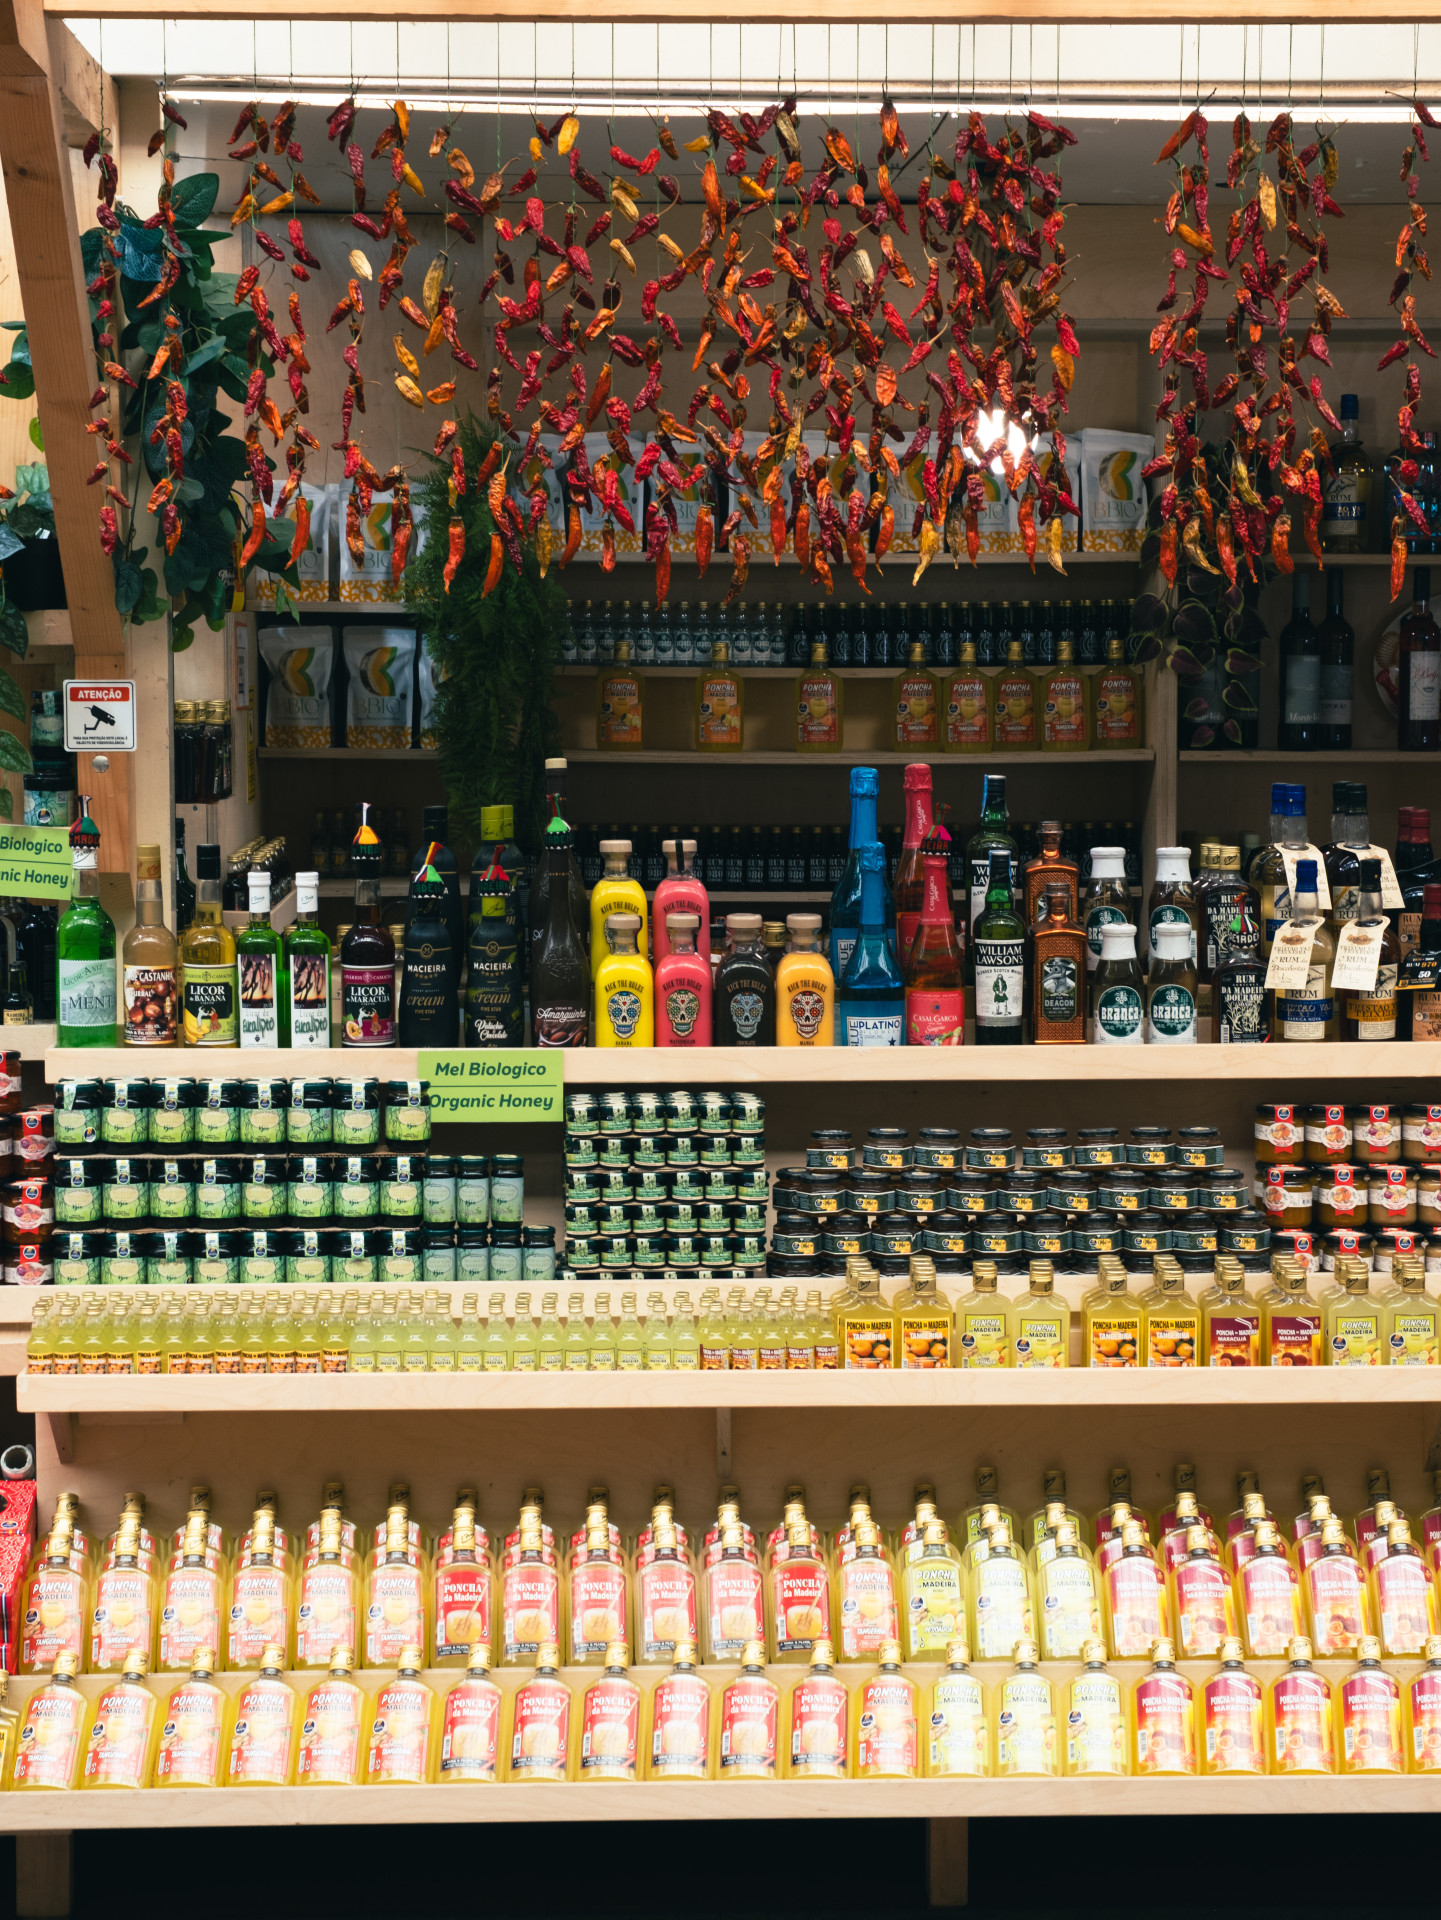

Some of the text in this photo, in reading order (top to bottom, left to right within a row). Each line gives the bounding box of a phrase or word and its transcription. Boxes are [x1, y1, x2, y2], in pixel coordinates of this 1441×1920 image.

[705, 684, 735, 692] PONCHA
[803, 683, 832, 691] PONCHA
[903, 683, 932, 691] PONCHA
[953, 683, 983, 691] PONCHA
[1051, 682, 1080, 690] PONCHA
[1102, 680, 1132, 688] PONCHA
[78, 689, 122, 701] ATENÇÃO
[24, 868, 68, 889] Honey
[978, 945, 1022, 956] WILLIAM
[976, 955, 1024, 965] LAWSON'S
[407, 964, 447, 973] MACIEIRA
[473, 962, 513, 971] MACIEIRA
[1235, 974, 1256, 983] RUM
[1418, 970, 1432, 979] 50
[618, 979, 628, 988] THE
[787, 981, 800, 993] KICK
[800, 979, 811, 989] THE
[191, 985, 226, 997] LICOR
[350, 986, 386, 997] LICOR
[1290, 989, 1318, 999] RUM
[1367, 989, 1393, 999] RUM
[195, 995, 227, 1003] BANANA
[351, 993, 391, 1004] MARACUJÁ
[406, 995, 445, 1007] cream
[472, 993, 511, 1005] cream
[1044, 999, 1074, 1007] DEACON
[913, 1013, 958, 1022] CASAL GARCIA
[858, 1019, 901, 1030] PLATINO
[435, 1062, 547, 1079] Mel Biologico
[430, 1094, 554, 1111] Organic Honey
[846, 1321, 892, 1331] PONCHA MADEIRA
[903, 1320, 949, 1330] PONCHA MADEIRA
[970, 1319, 1001, 1327] PONCHA
[1025, 1324, 1057, 1332] PONCHA
[1092, 1320, 1138, 1330] PONCHA MADEIRA
[1150, 1320, 1196, 1329] PONCHA MADEIRA
[1399, 1319, 1430, 1327] PONCHA
[916, 1569, 956, 1581] PONCHA
[32, 1581, 73, 1594] PONCHA
[444, 1583, 482, 1594] PONCHA
[783, 1578, 821, 1589] PONCHA
[923, 1580, 957, 1589] MADEIRA
[443, 1592, 483, 1603] da Madeira
[783, 1587, 823, 1598] da Madeira
[382, 1692, 422, 1705] PONCHA
[867, 1687, 908, 1700] PONCHA
[32, 1699, 72, 1711] PONCHA
[102, 1695, 143, 1708] PONCHA
[523, 1697, 561, 1707] PONCHA
